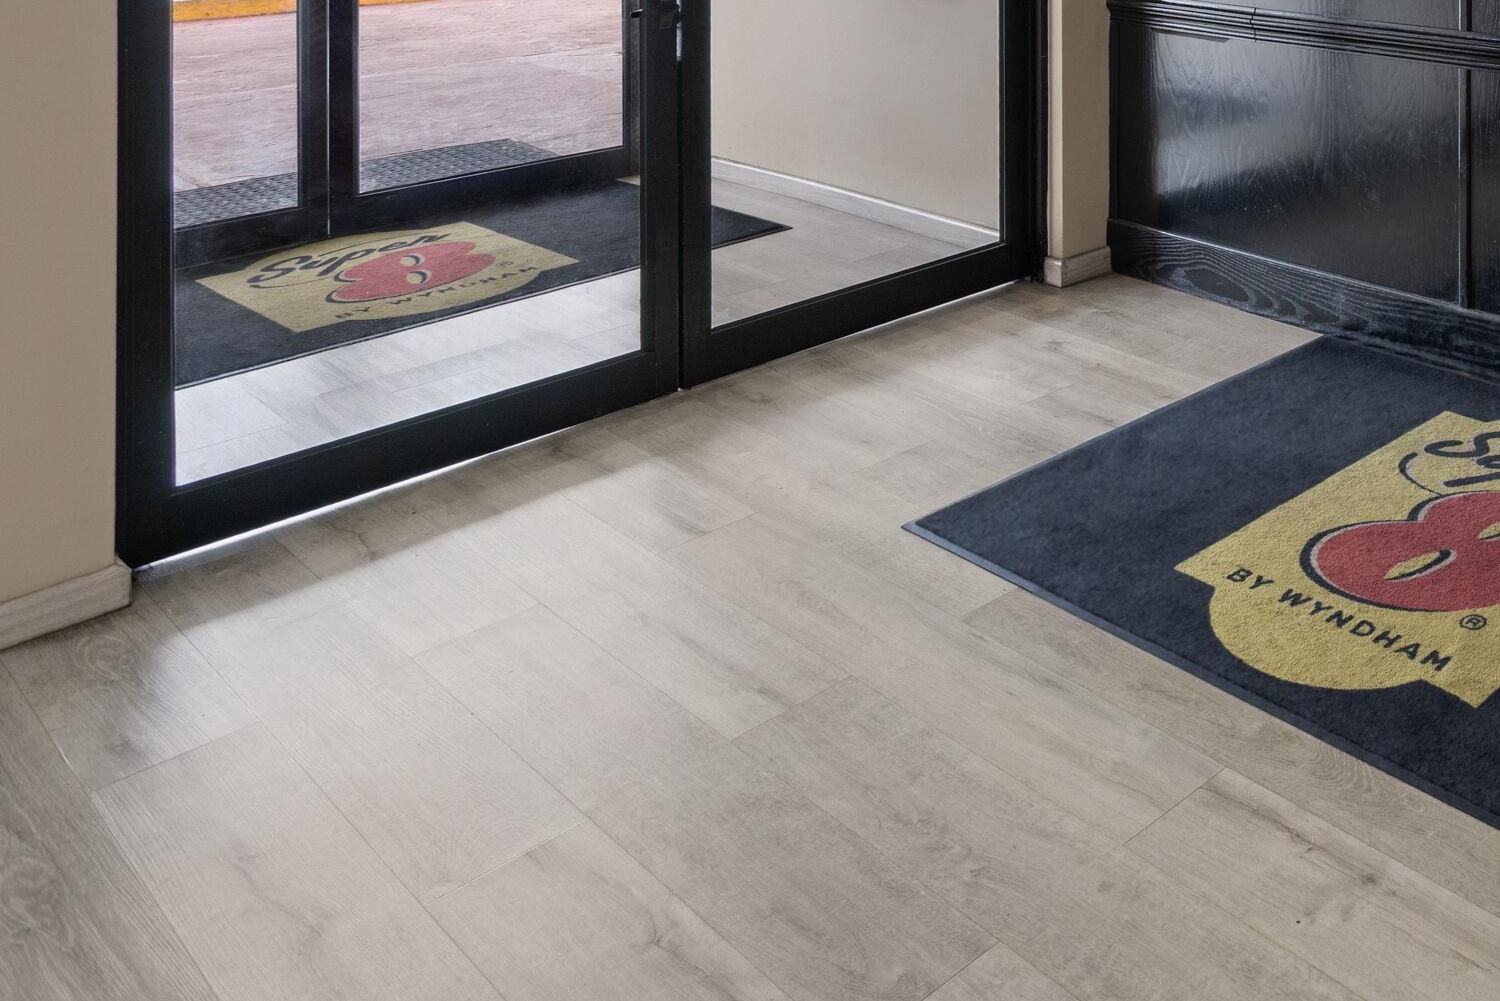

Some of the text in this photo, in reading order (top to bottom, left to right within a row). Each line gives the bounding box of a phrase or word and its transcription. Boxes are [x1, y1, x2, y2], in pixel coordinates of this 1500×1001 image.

[246, 233, 451, 284] Super
[335, 266, 539, 319] BY WYNDHAM
[1226, 568, 1453, 673] BY WYNDHAM
